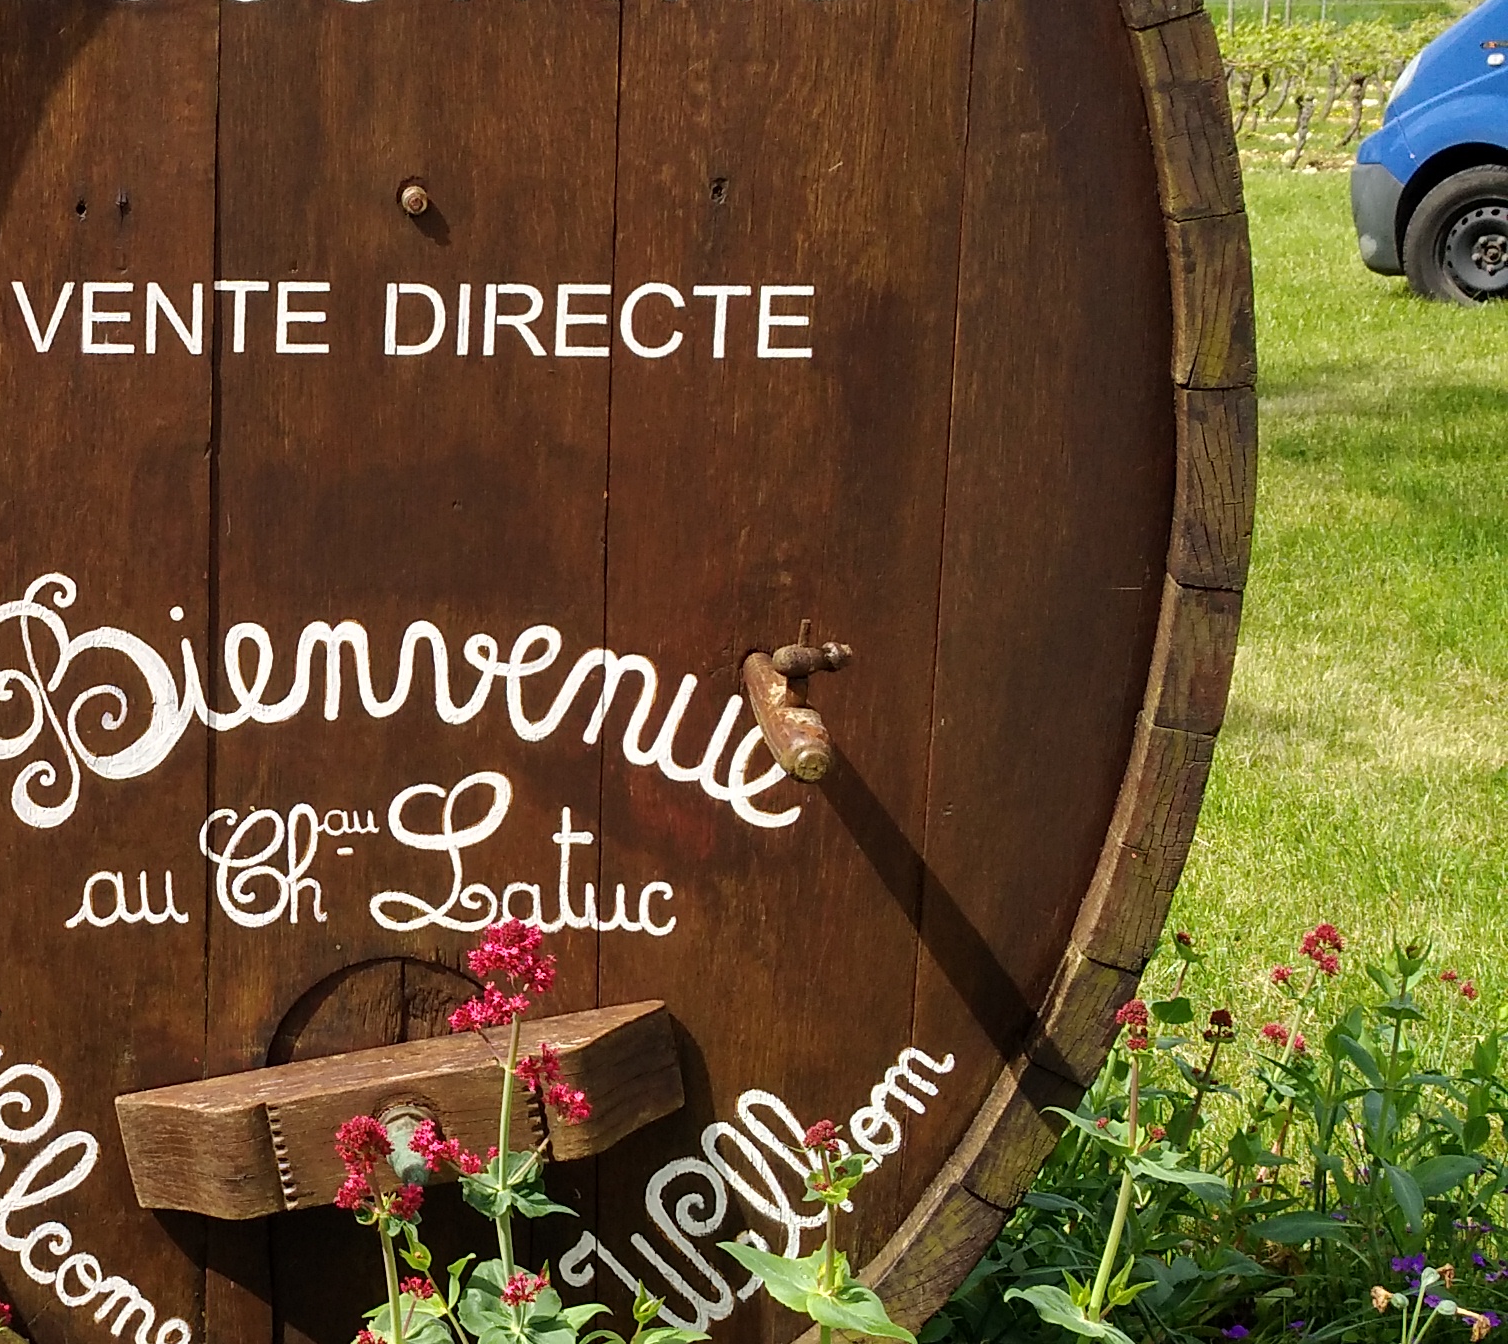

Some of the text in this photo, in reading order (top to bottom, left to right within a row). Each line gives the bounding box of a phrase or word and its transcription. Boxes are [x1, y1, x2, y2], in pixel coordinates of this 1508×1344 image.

[11, 281, 815, 359] VENTE DIRECTE
[65, 870, 189, 929] au
[370, 771, 677, 936] Latuc
